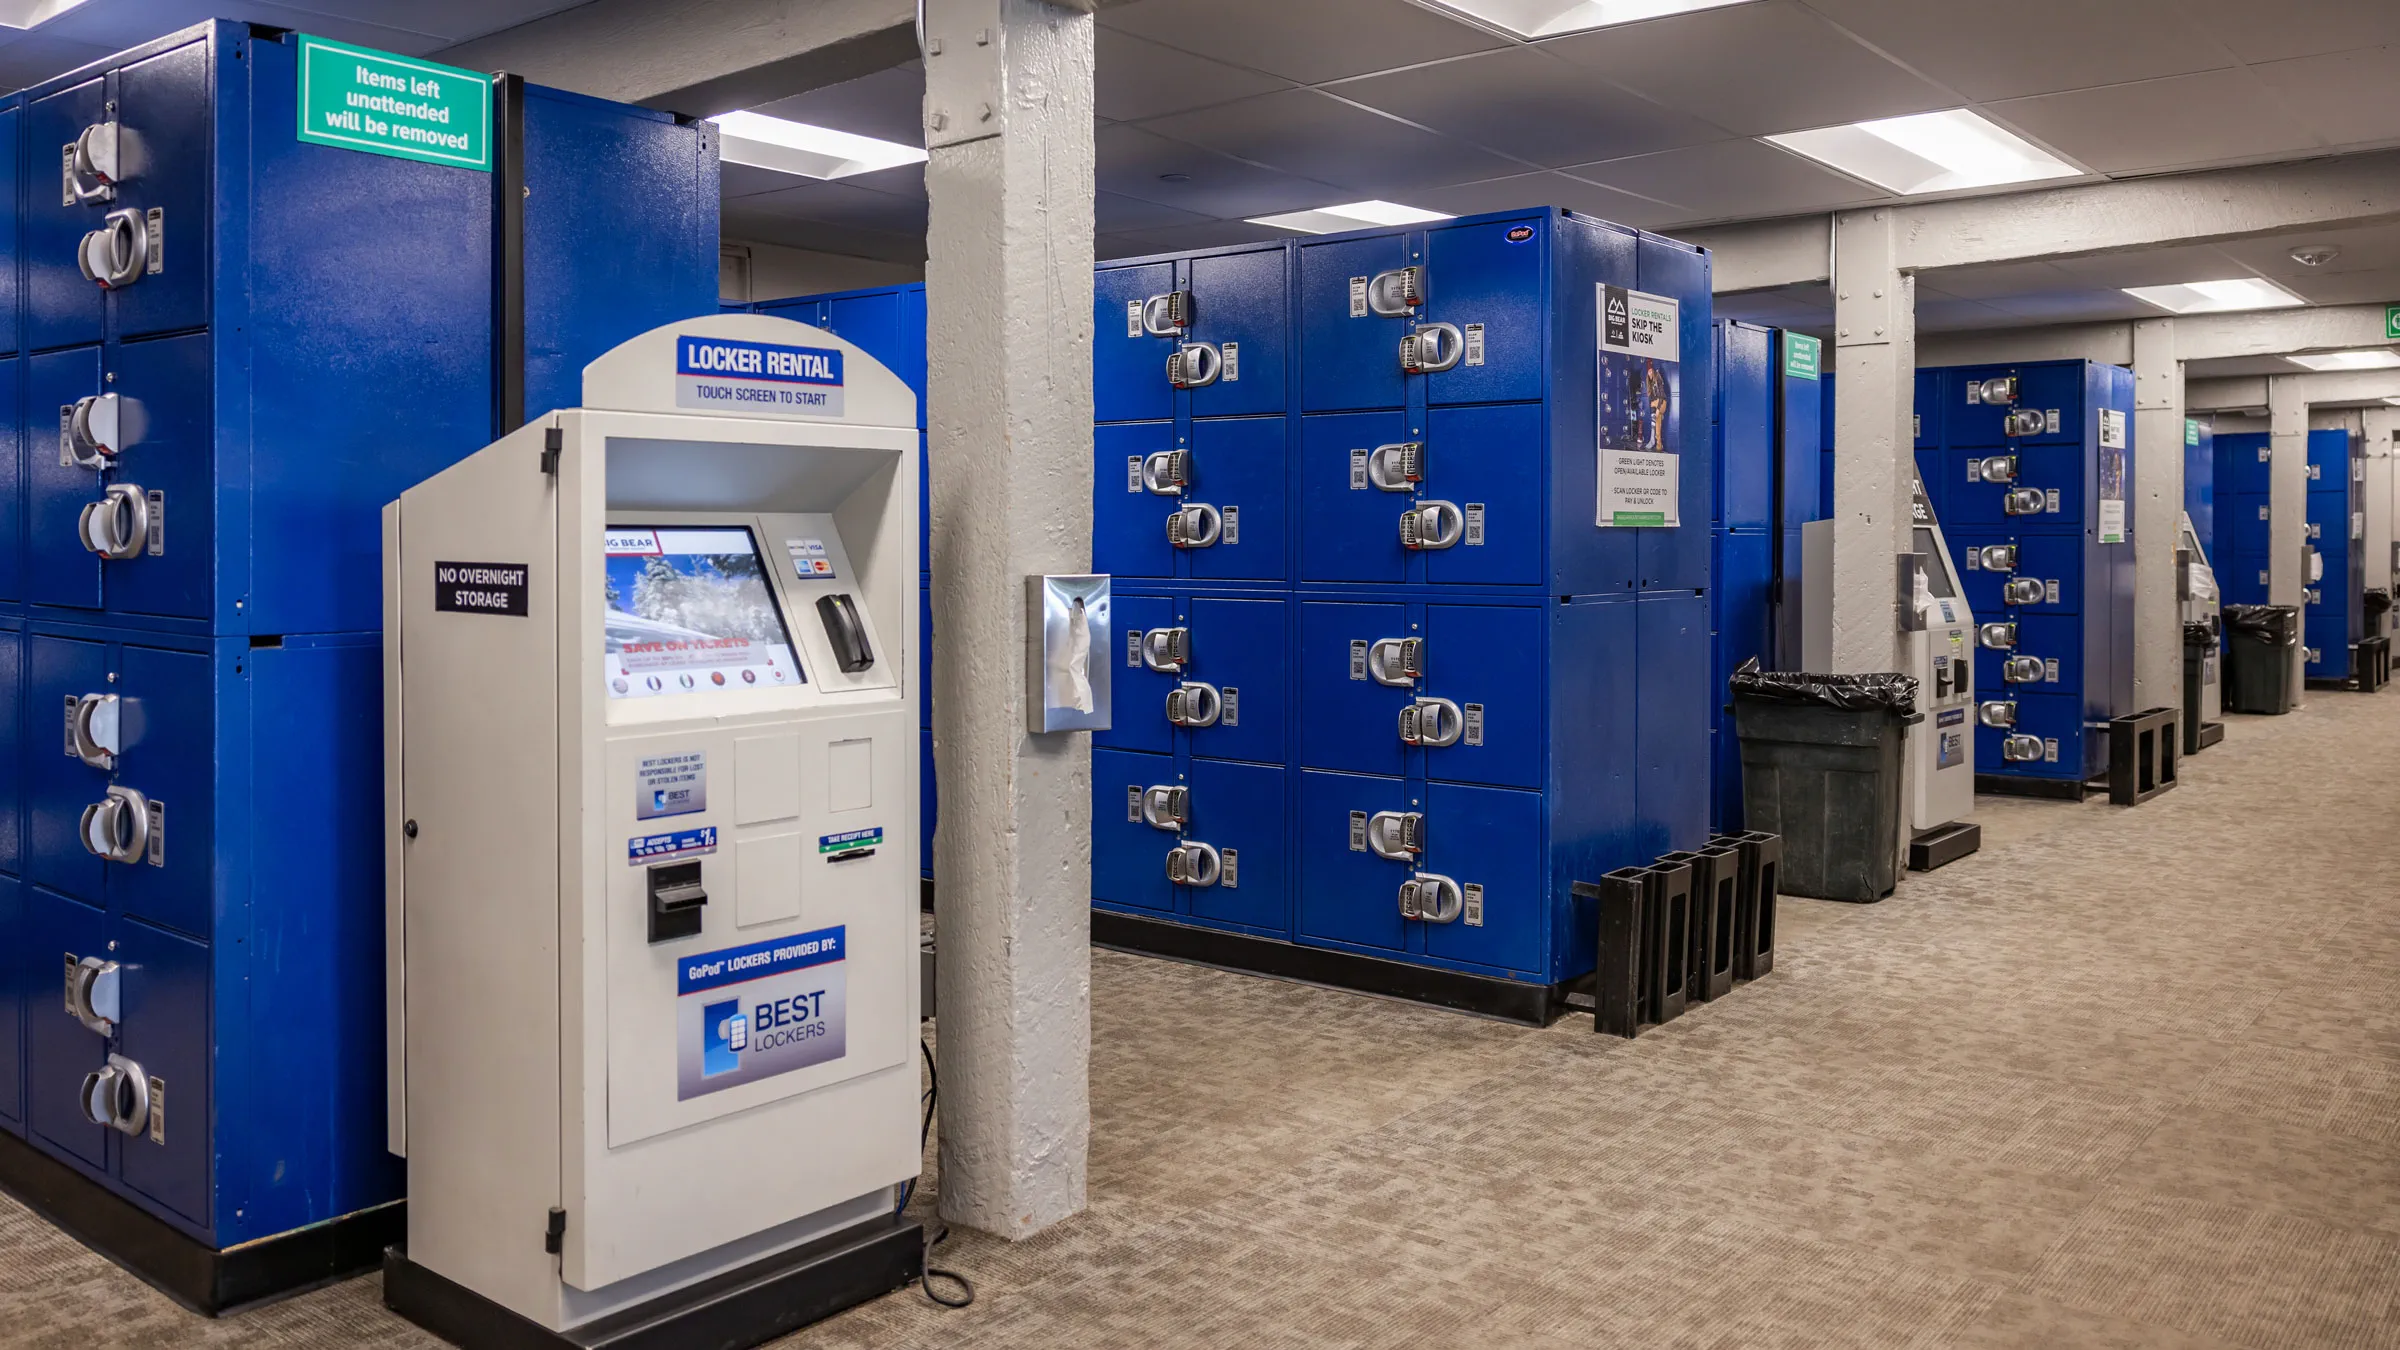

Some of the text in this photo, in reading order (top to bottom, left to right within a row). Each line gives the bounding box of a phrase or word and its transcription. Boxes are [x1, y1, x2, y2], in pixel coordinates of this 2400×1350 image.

[356, 65, 440, 99] Items left
[346, 91, 449, 124] unattended
[325, 111, 468, 150] will be removed
[1632, 307, 1672, 322] LOCKER RENTALS
[1632, 318, 1662, 334] SKIP THE
[1632, 331, 1654, 345] KIOSK
[688, 344, 834, 380] LOCKER RENTAL
[696, 385, 827, 406] TOUCH SCREEN TO START
[620, 538, 653, 547] BEAR
[439, 568, 524, 586] NO OVERNIGHT
[455, 590, 508, 608] STORAGE
[622, 637, 750, 653] SAVE ON TICKETS
[657, 757, 681, 766] LOCKERS
[668, 789, 690, 800] BEST
[728, 951, 771, 972] LOCKERS
[774, 941, 819, 962] PROVIDED
[822, 938, 836, 952] BY:
[755, 990, 825, 1032] BEST
[755, 1021, 825, 1052] LOCKERS
